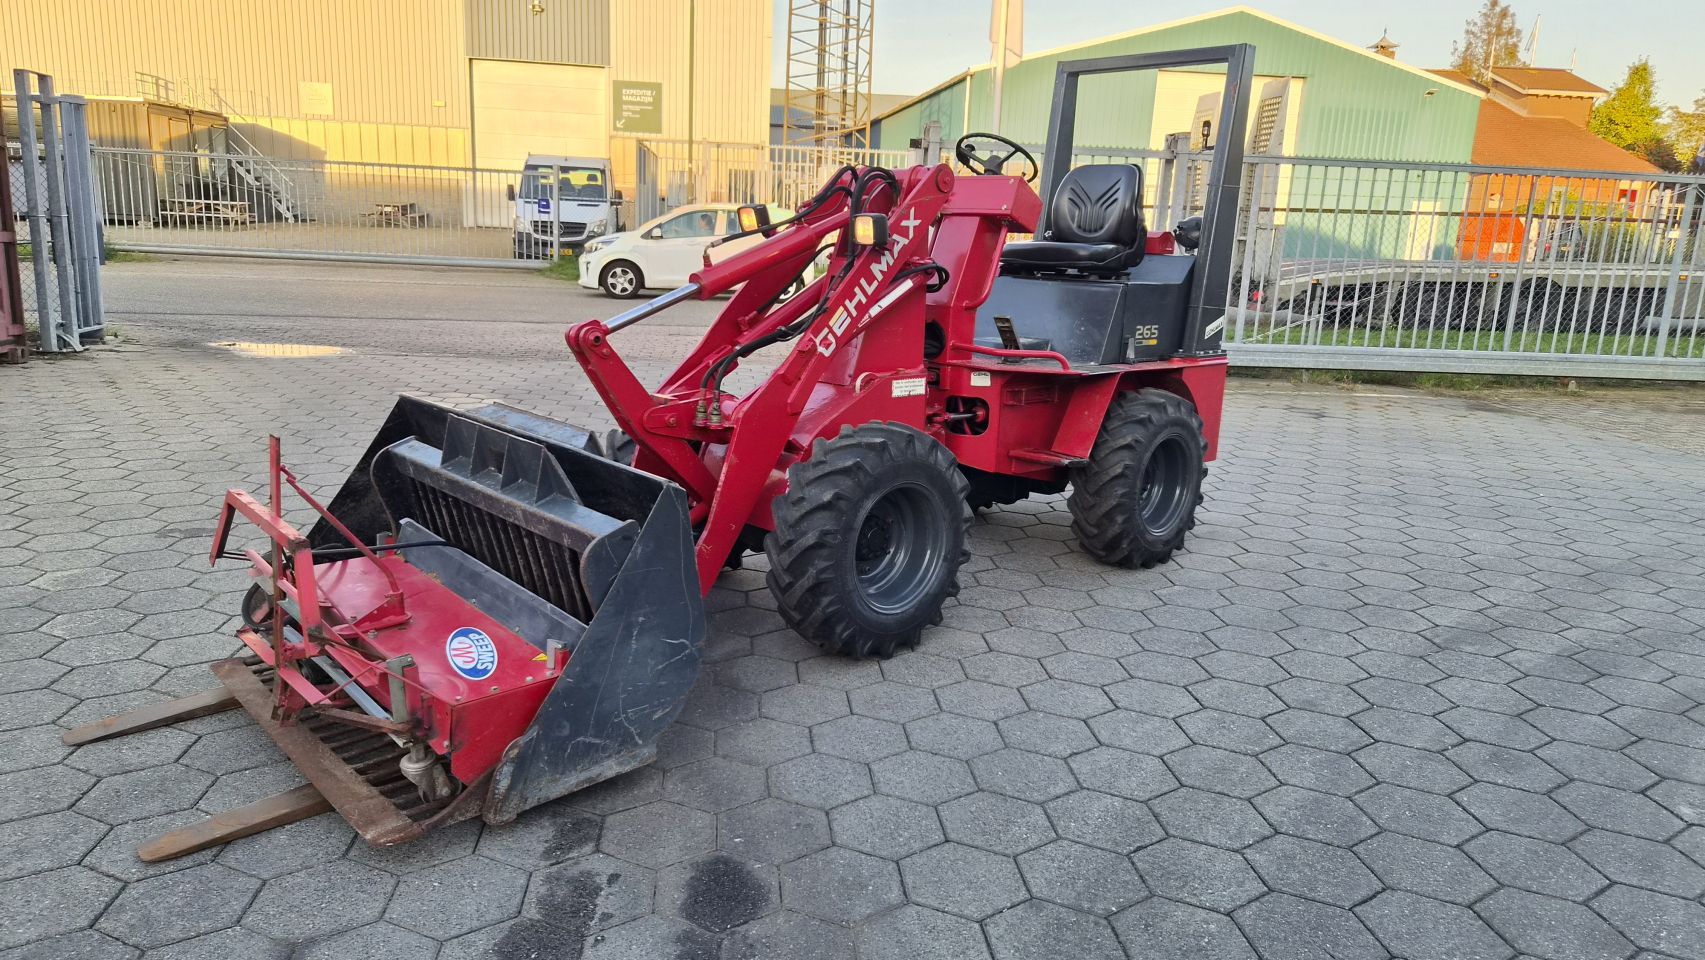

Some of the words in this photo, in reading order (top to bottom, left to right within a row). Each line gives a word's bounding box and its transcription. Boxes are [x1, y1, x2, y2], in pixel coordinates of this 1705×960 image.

[815, 206, 922, 358] GEHLMAX
[1135, 325, 1159, 338] 265
[468, 633, 493, 670] SWEEP
